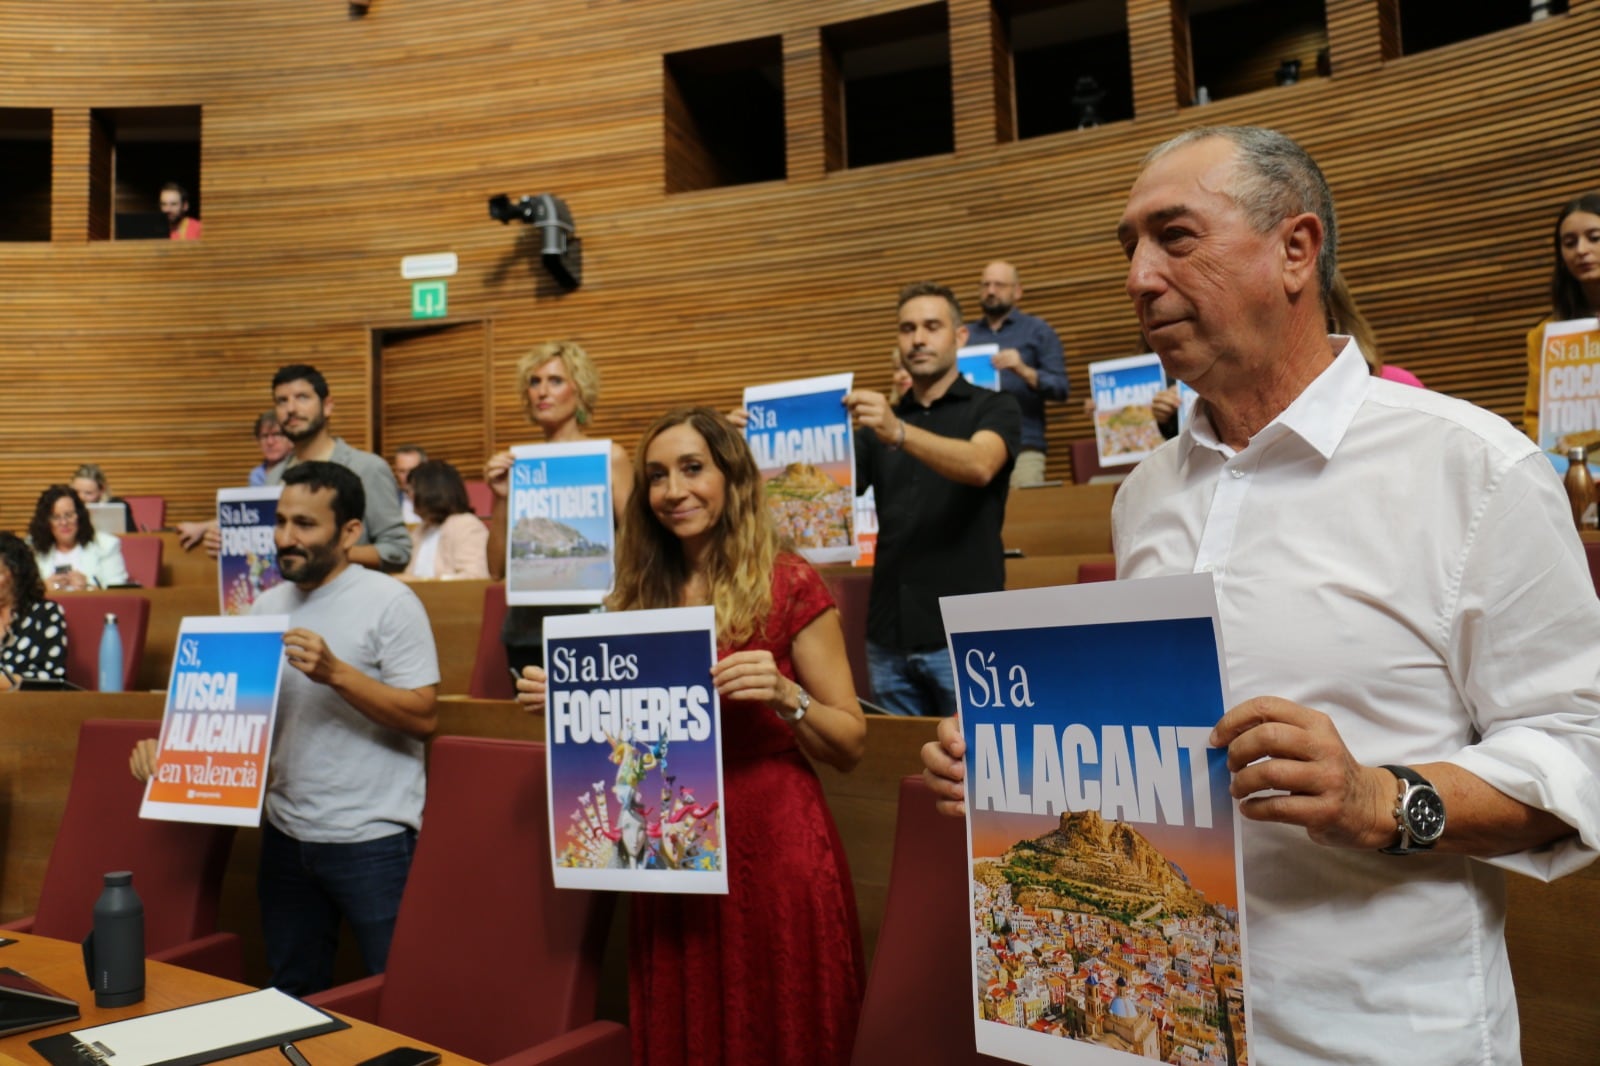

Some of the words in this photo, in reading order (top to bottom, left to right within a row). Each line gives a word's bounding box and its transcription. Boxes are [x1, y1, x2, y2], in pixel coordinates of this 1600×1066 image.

[1568, 342, 1580, 360] a
[766, 408, 777, 428] a
[749, 424, 846, 468] ALACANT
[533, 461, 547, 485] al
[515, 485, 605, 519] POSTIGUET
[553, 647, 578, 683] Sí
[581, 655, 599, 681] a
[599, 643, 639, 680] les
[965, 649, 1005, 707] Sí
[1008, 664, 1034, 707] a
[175, 672, 238, 711] VISCA
[553, 685, 711, 744] FOGUERES
[165, 714, 267, 755] ALACANT
[158, 763, 181, 784] en
[185, 756, 257, 787] valencià
[975, 723, 1217, 828] ALACANT
